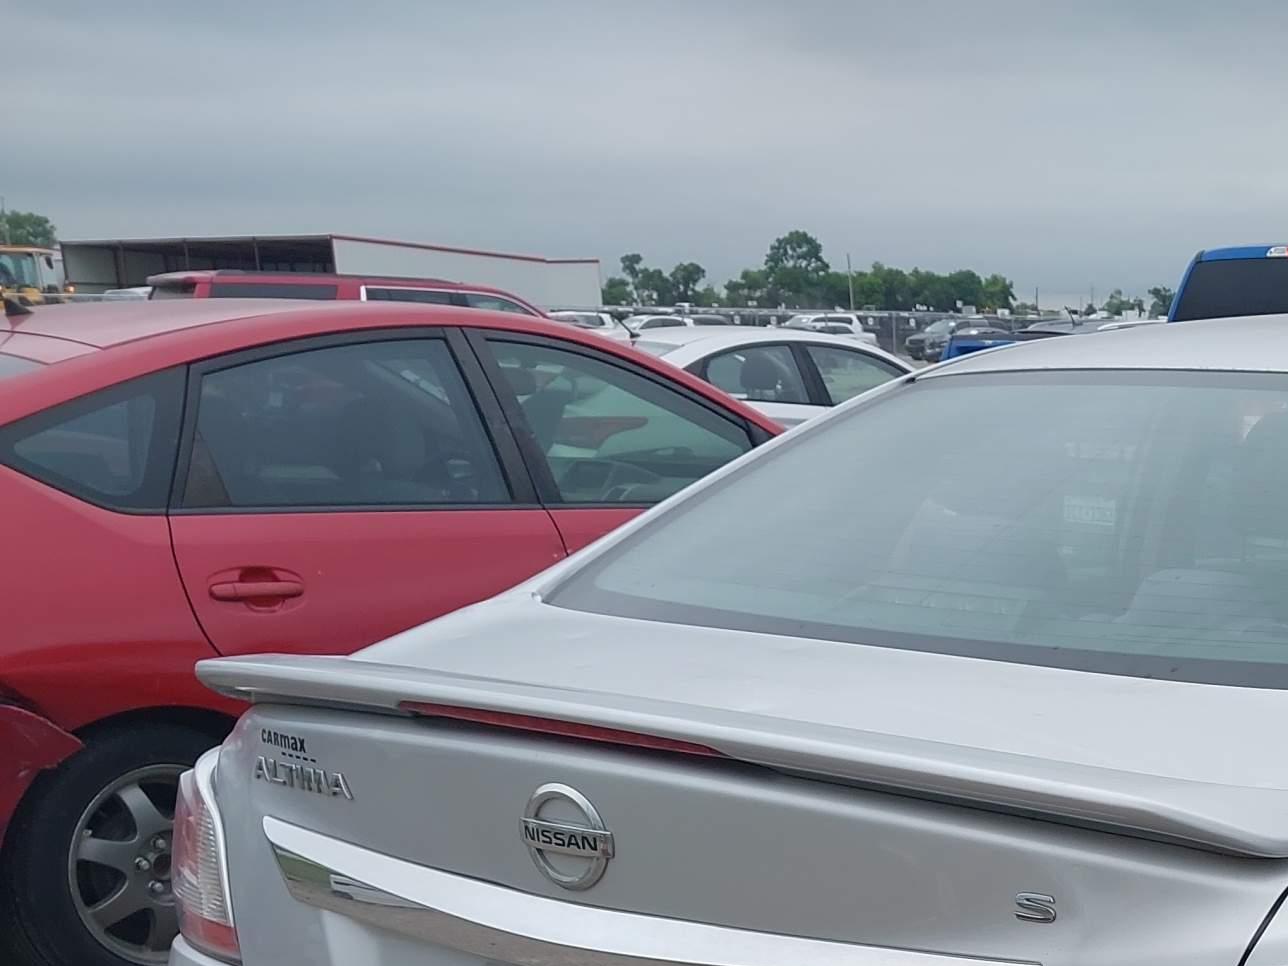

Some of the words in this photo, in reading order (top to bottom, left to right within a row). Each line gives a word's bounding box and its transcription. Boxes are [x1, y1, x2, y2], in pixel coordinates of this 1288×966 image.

[255, 755, 354, 800] ALTIMA
[523, 825, 598, 851] NISSAN
[1014, 891, 1056, 923] S
